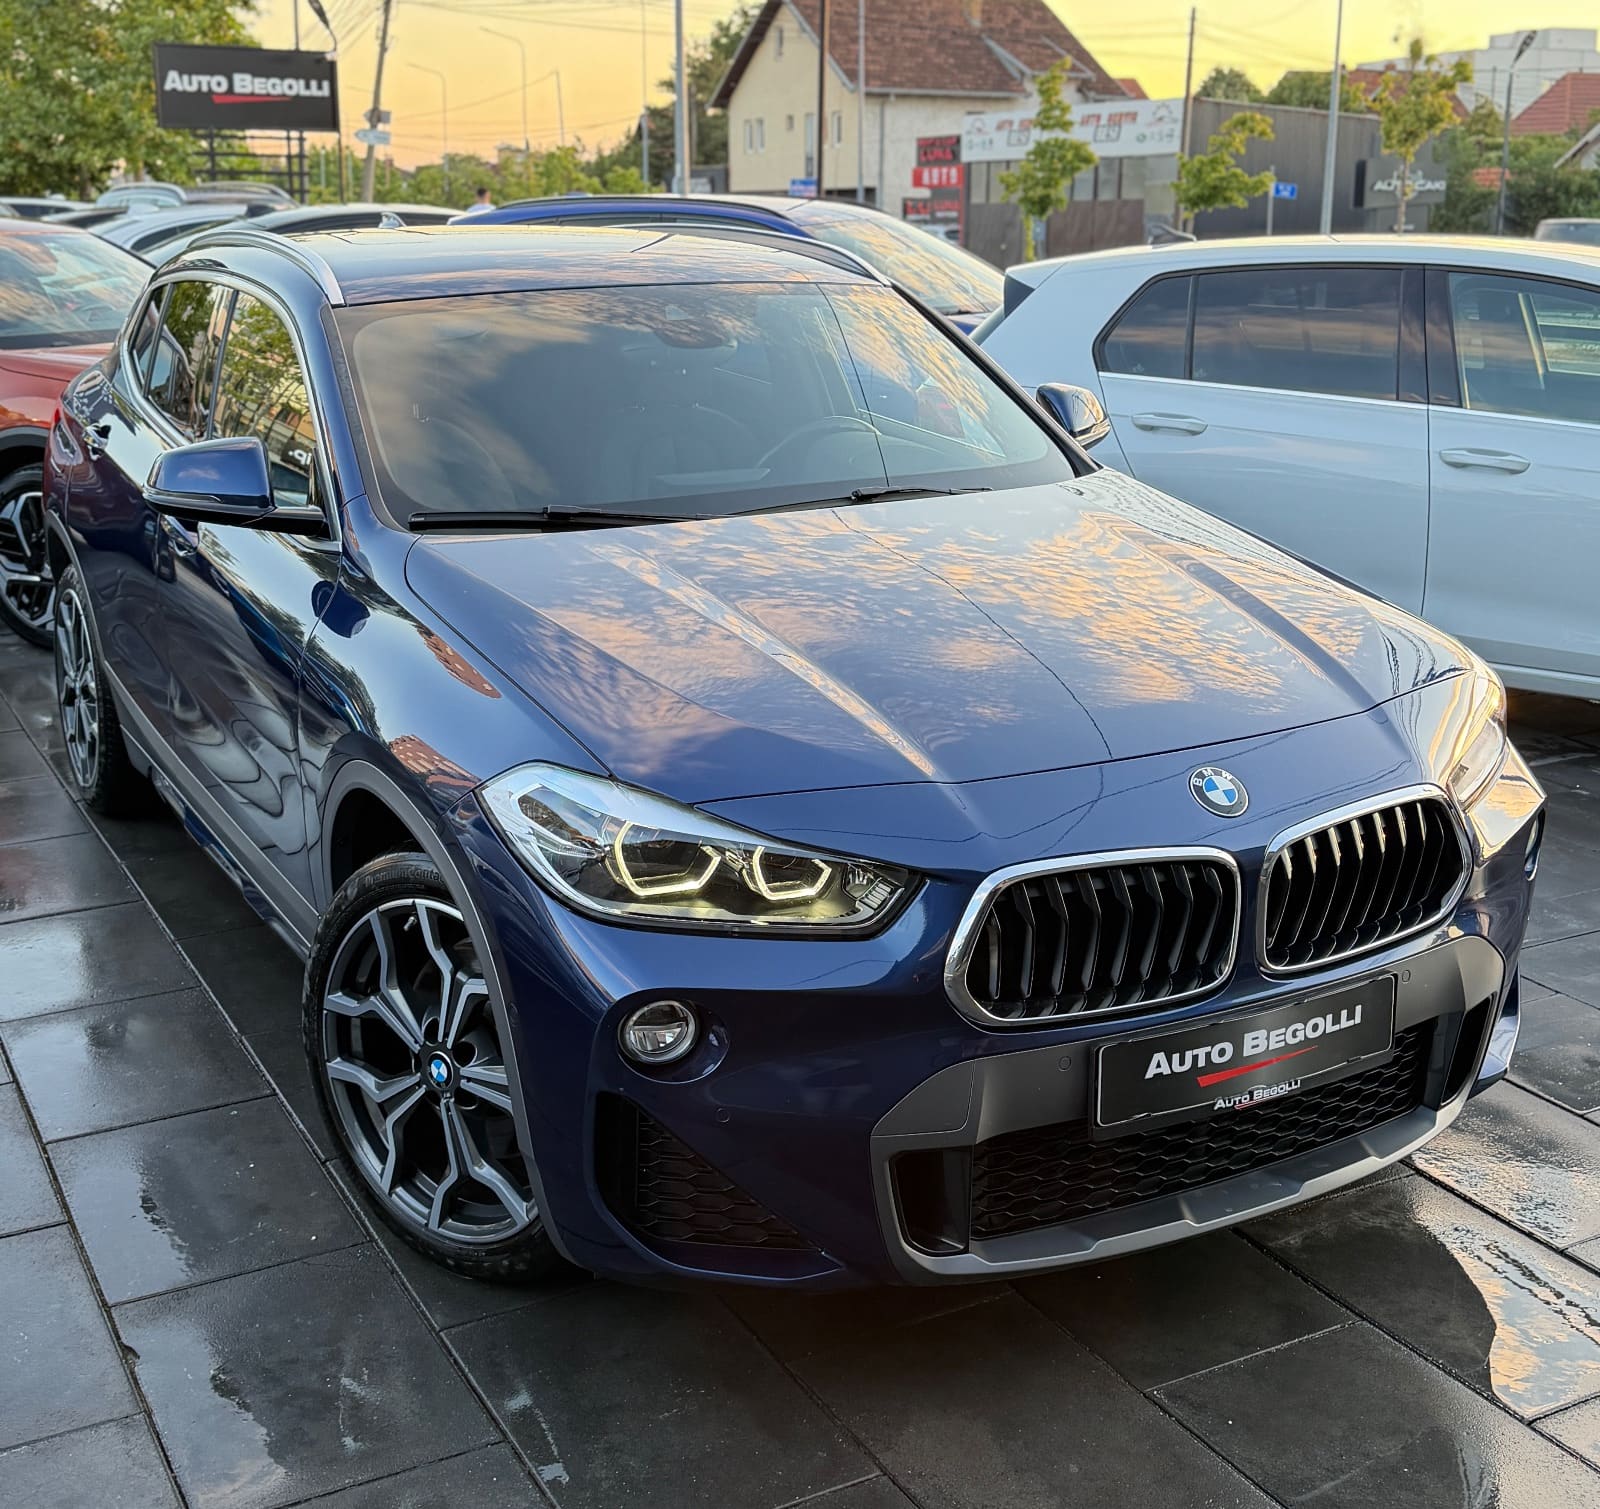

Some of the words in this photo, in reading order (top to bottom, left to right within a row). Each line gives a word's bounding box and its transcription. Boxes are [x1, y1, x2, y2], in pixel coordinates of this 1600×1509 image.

[163, 70, 229, 93] AUTO
[232, 72, 330, 97] BEGOLLI
[922, 166, 958, 184] AUTO
[1192, 766, 1233, 786] BMW
[1144, 1041, 1234, 1080] AUTO
[1242, 1004, 1362, 1057] BEGOLLI
[1214, 1094, 1250, 1110] AUTO
[1253, 1079, 1301, 1101] BEGOLLI
